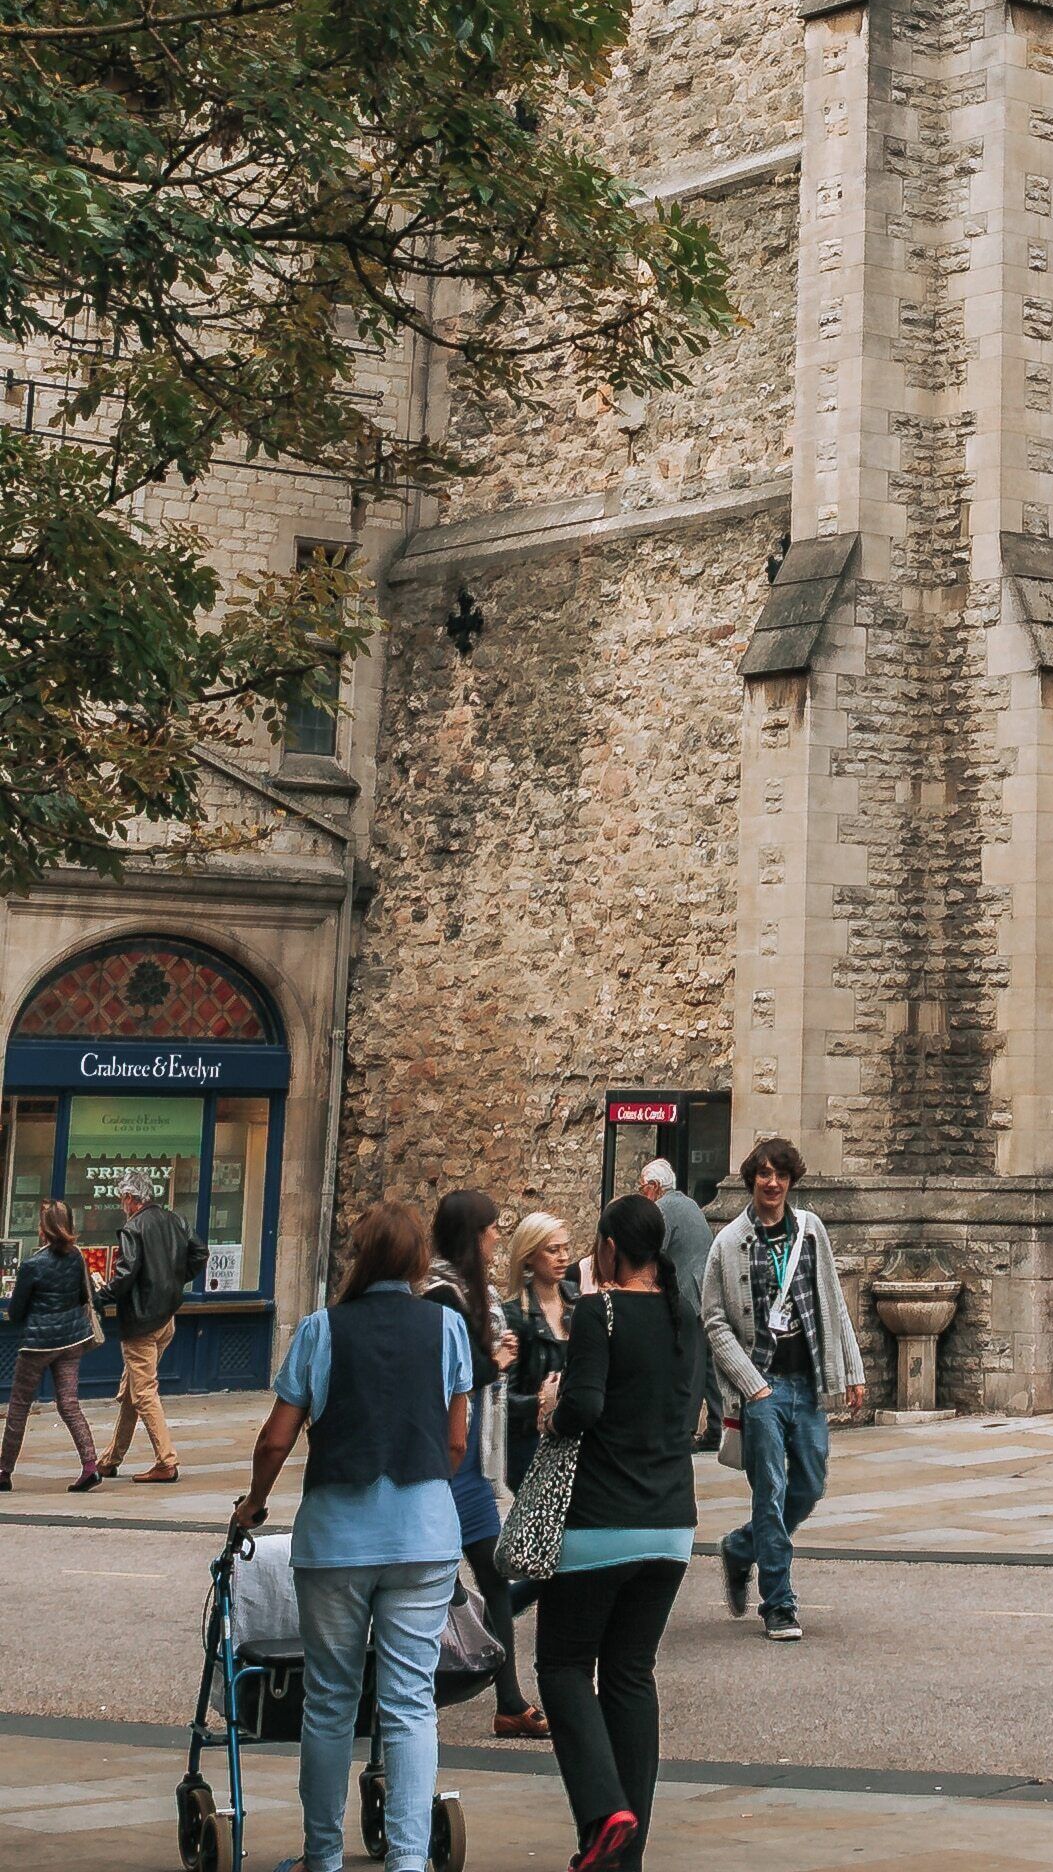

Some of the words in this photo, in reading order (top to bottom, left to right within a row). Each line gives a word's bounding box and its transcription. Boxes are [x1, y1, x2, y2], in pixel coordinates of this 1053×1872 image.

[81, 1052, 150, 1077] Crabtree
[152, 1056, 168, 1078] &
[168, 1054, 219, 1084] Evelyn
[617, 1106, 637, 1120] Coins
[637, 1109, 645, 1120] &
[644, 1106, 666, 1120] Cards
[94, 1184, 165, 1198] PICD
